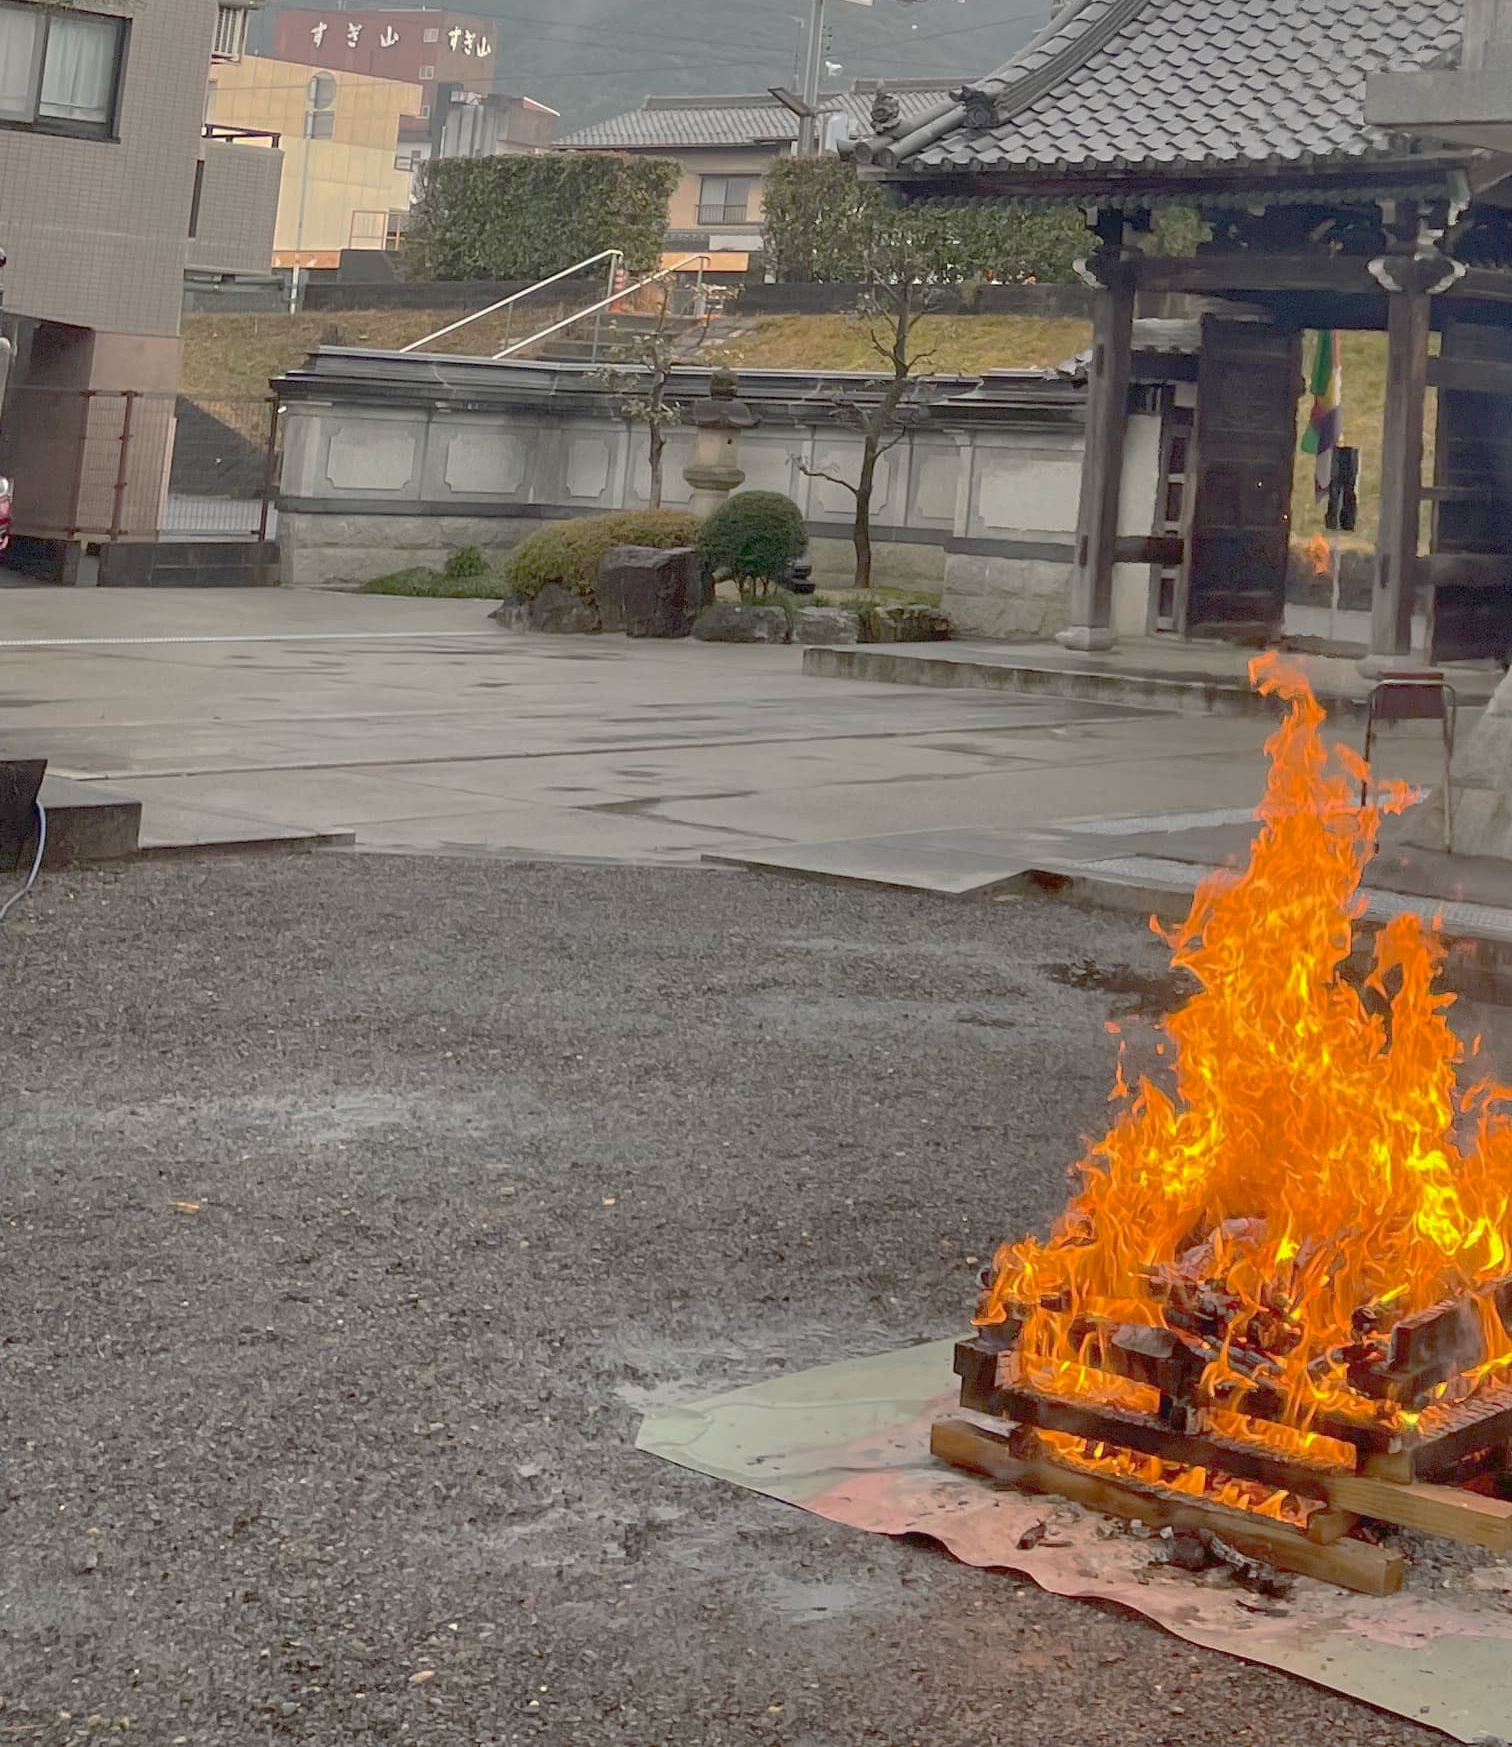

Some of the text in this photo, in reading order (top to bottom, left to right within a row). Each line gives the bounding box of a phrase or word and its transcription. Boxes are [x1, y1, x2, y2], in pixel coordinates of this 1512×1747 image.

[310, 22, 400, 48] すぎ山
[447, 26, 492, 58] すぎ山
